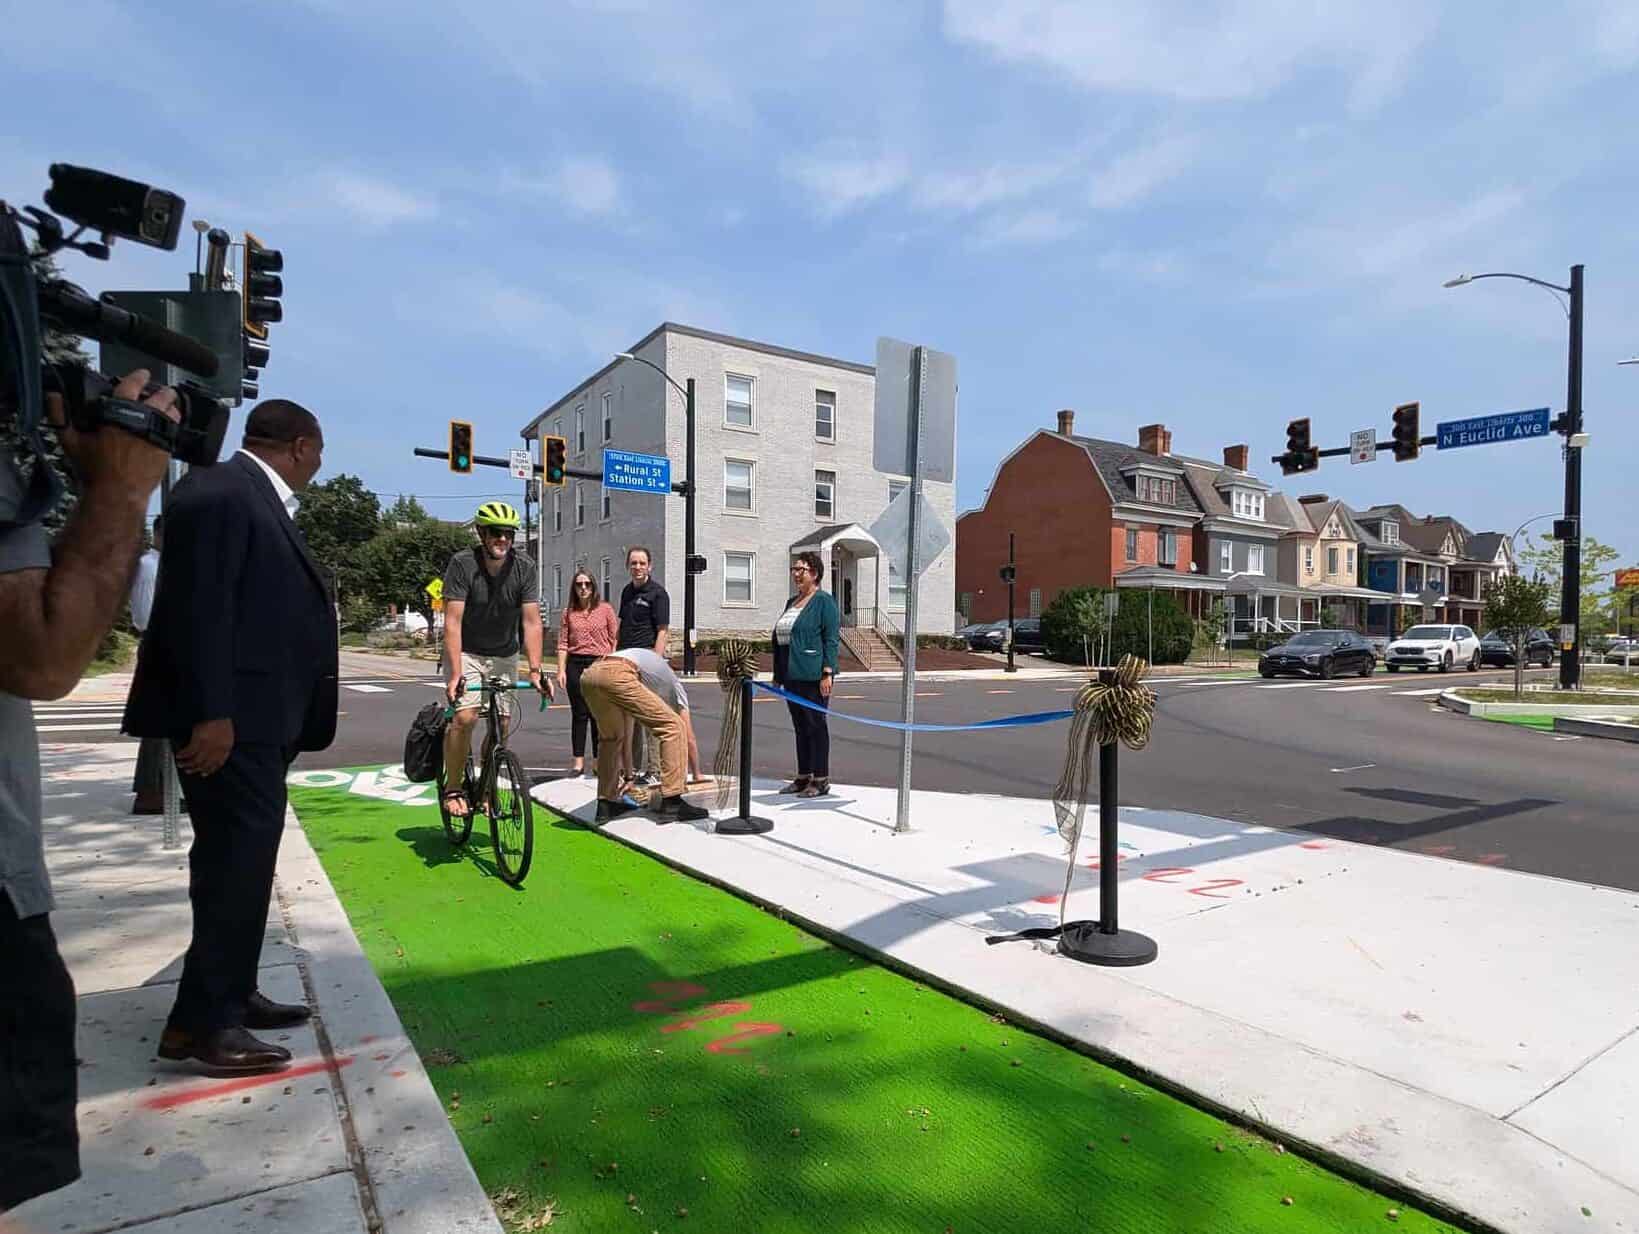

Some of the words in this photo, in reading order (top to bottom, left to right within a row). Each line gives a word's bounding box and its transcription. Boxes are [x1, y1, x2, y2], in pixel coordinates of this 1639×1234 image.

[1443, 434, 1453, 446] N
[1459, 426, 1505, 444] Euclid
[1513, 423, 1543, 437] Ave
[624, 464, 649, 476] Rural
[652, 467, 661, 477] St
[609, 473, 643, 486] Station
[647, 477, 656, 487] St
